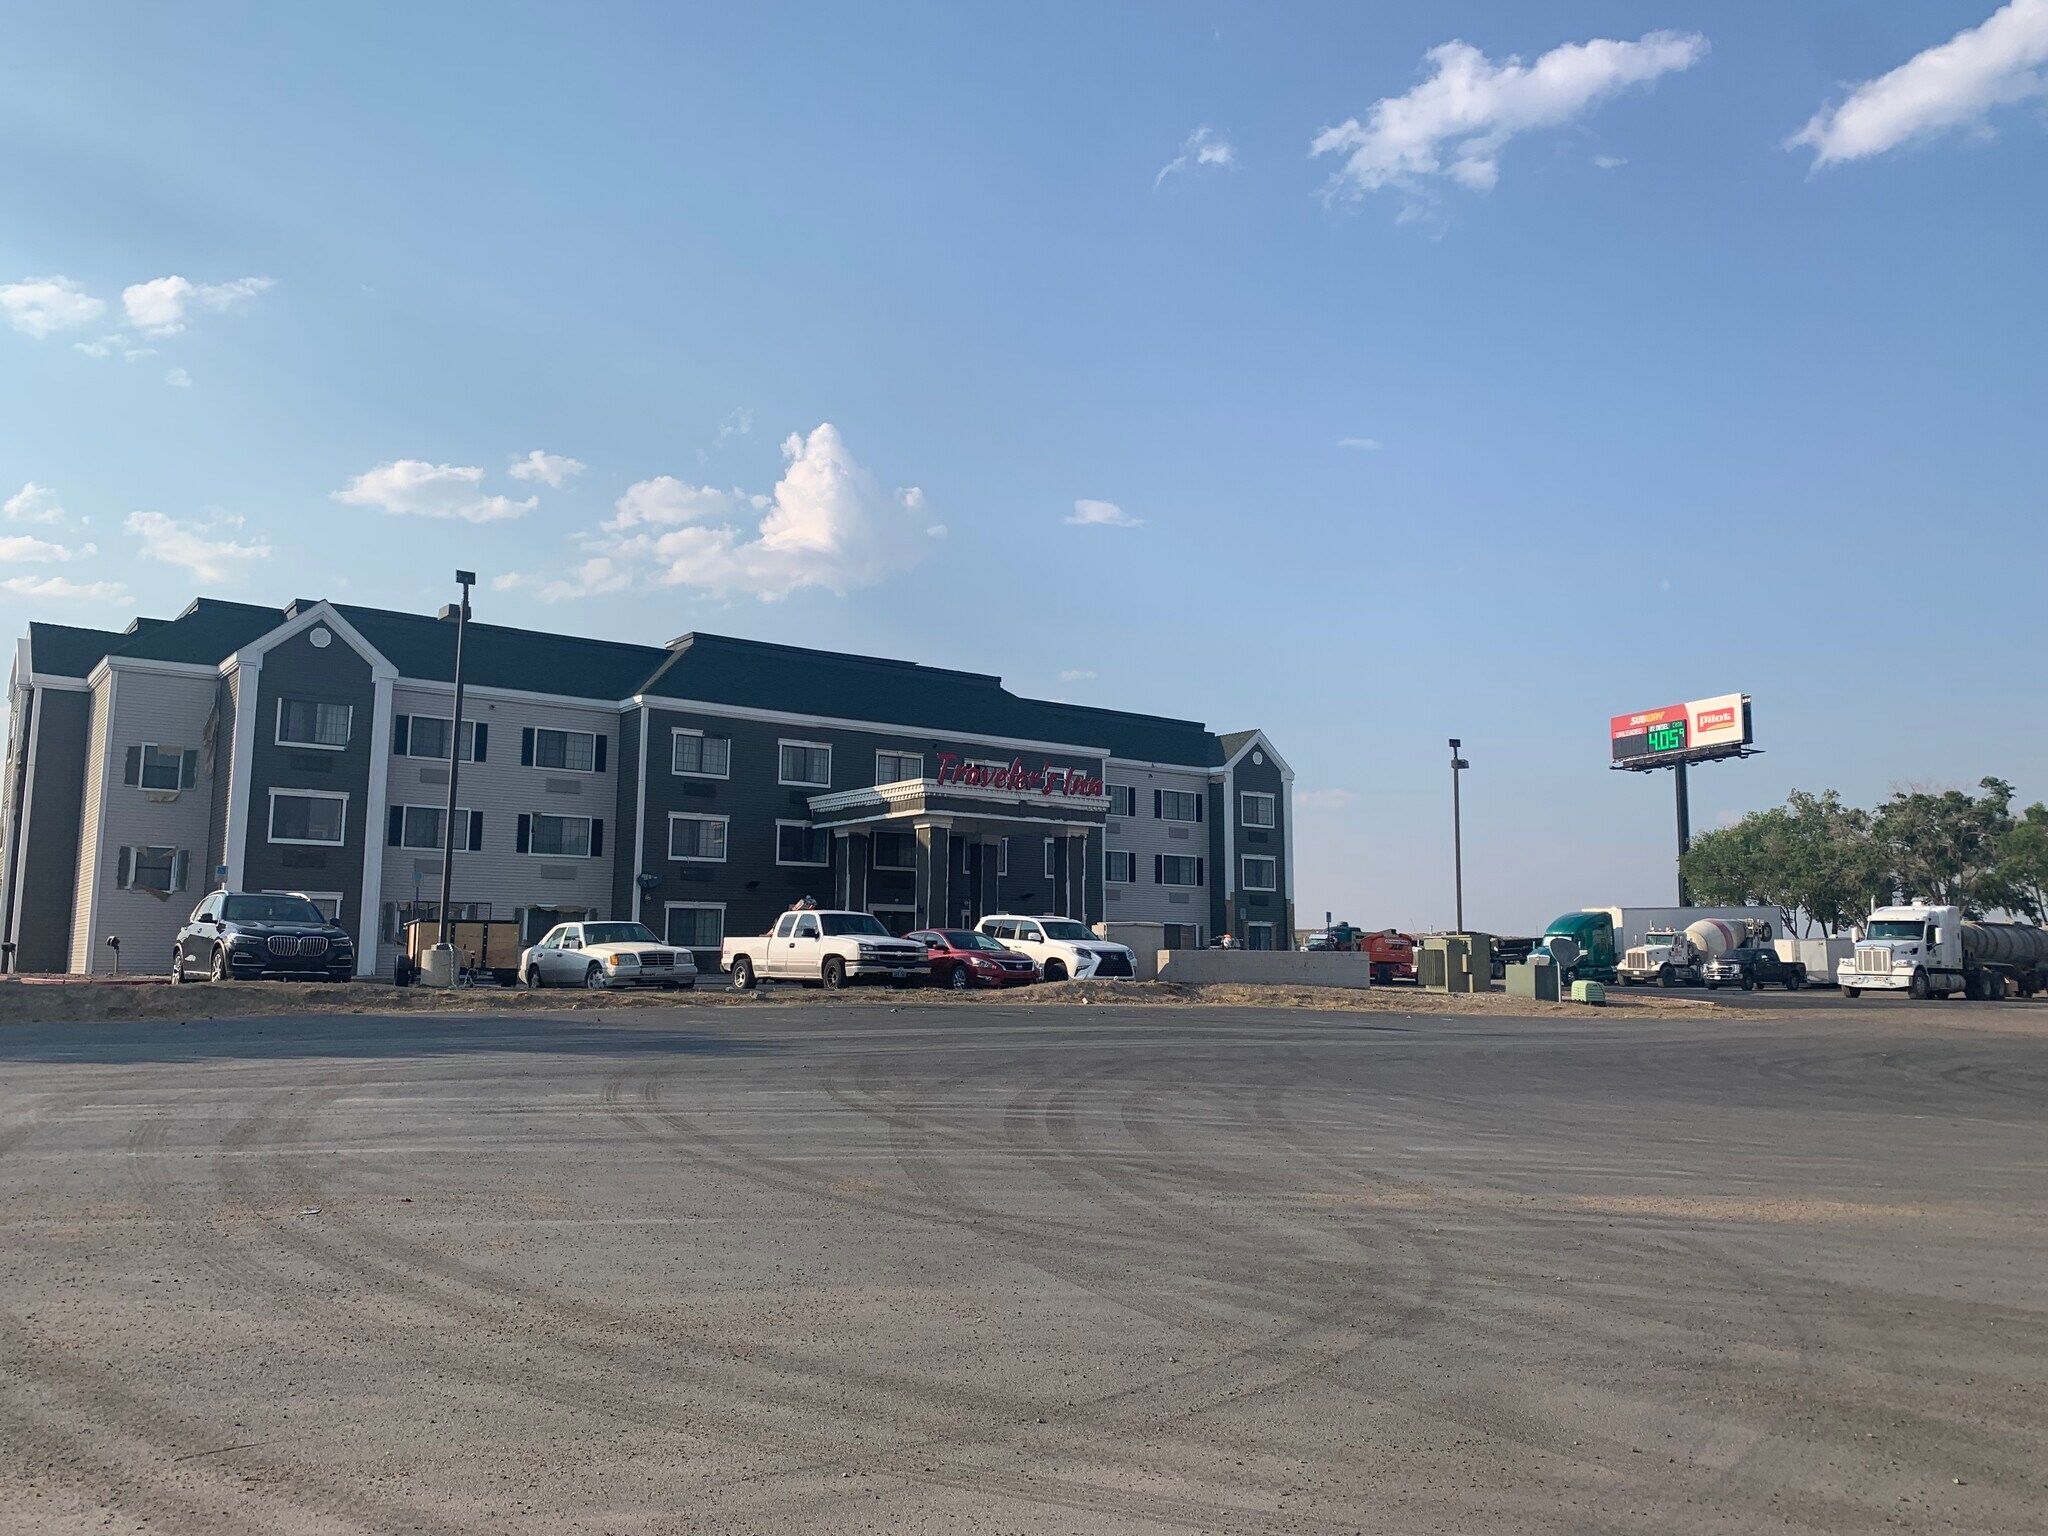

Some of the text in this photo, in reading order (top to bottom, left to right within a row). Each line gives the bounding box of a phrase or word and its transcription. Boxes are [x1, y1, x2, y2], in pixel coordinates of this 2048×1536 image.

[1630, 711, 1665, 725] SUBWAY
[1615, 728, 1643, 738] UNLEADED
[936, 752, 1104, 796] Traveler's Inn
